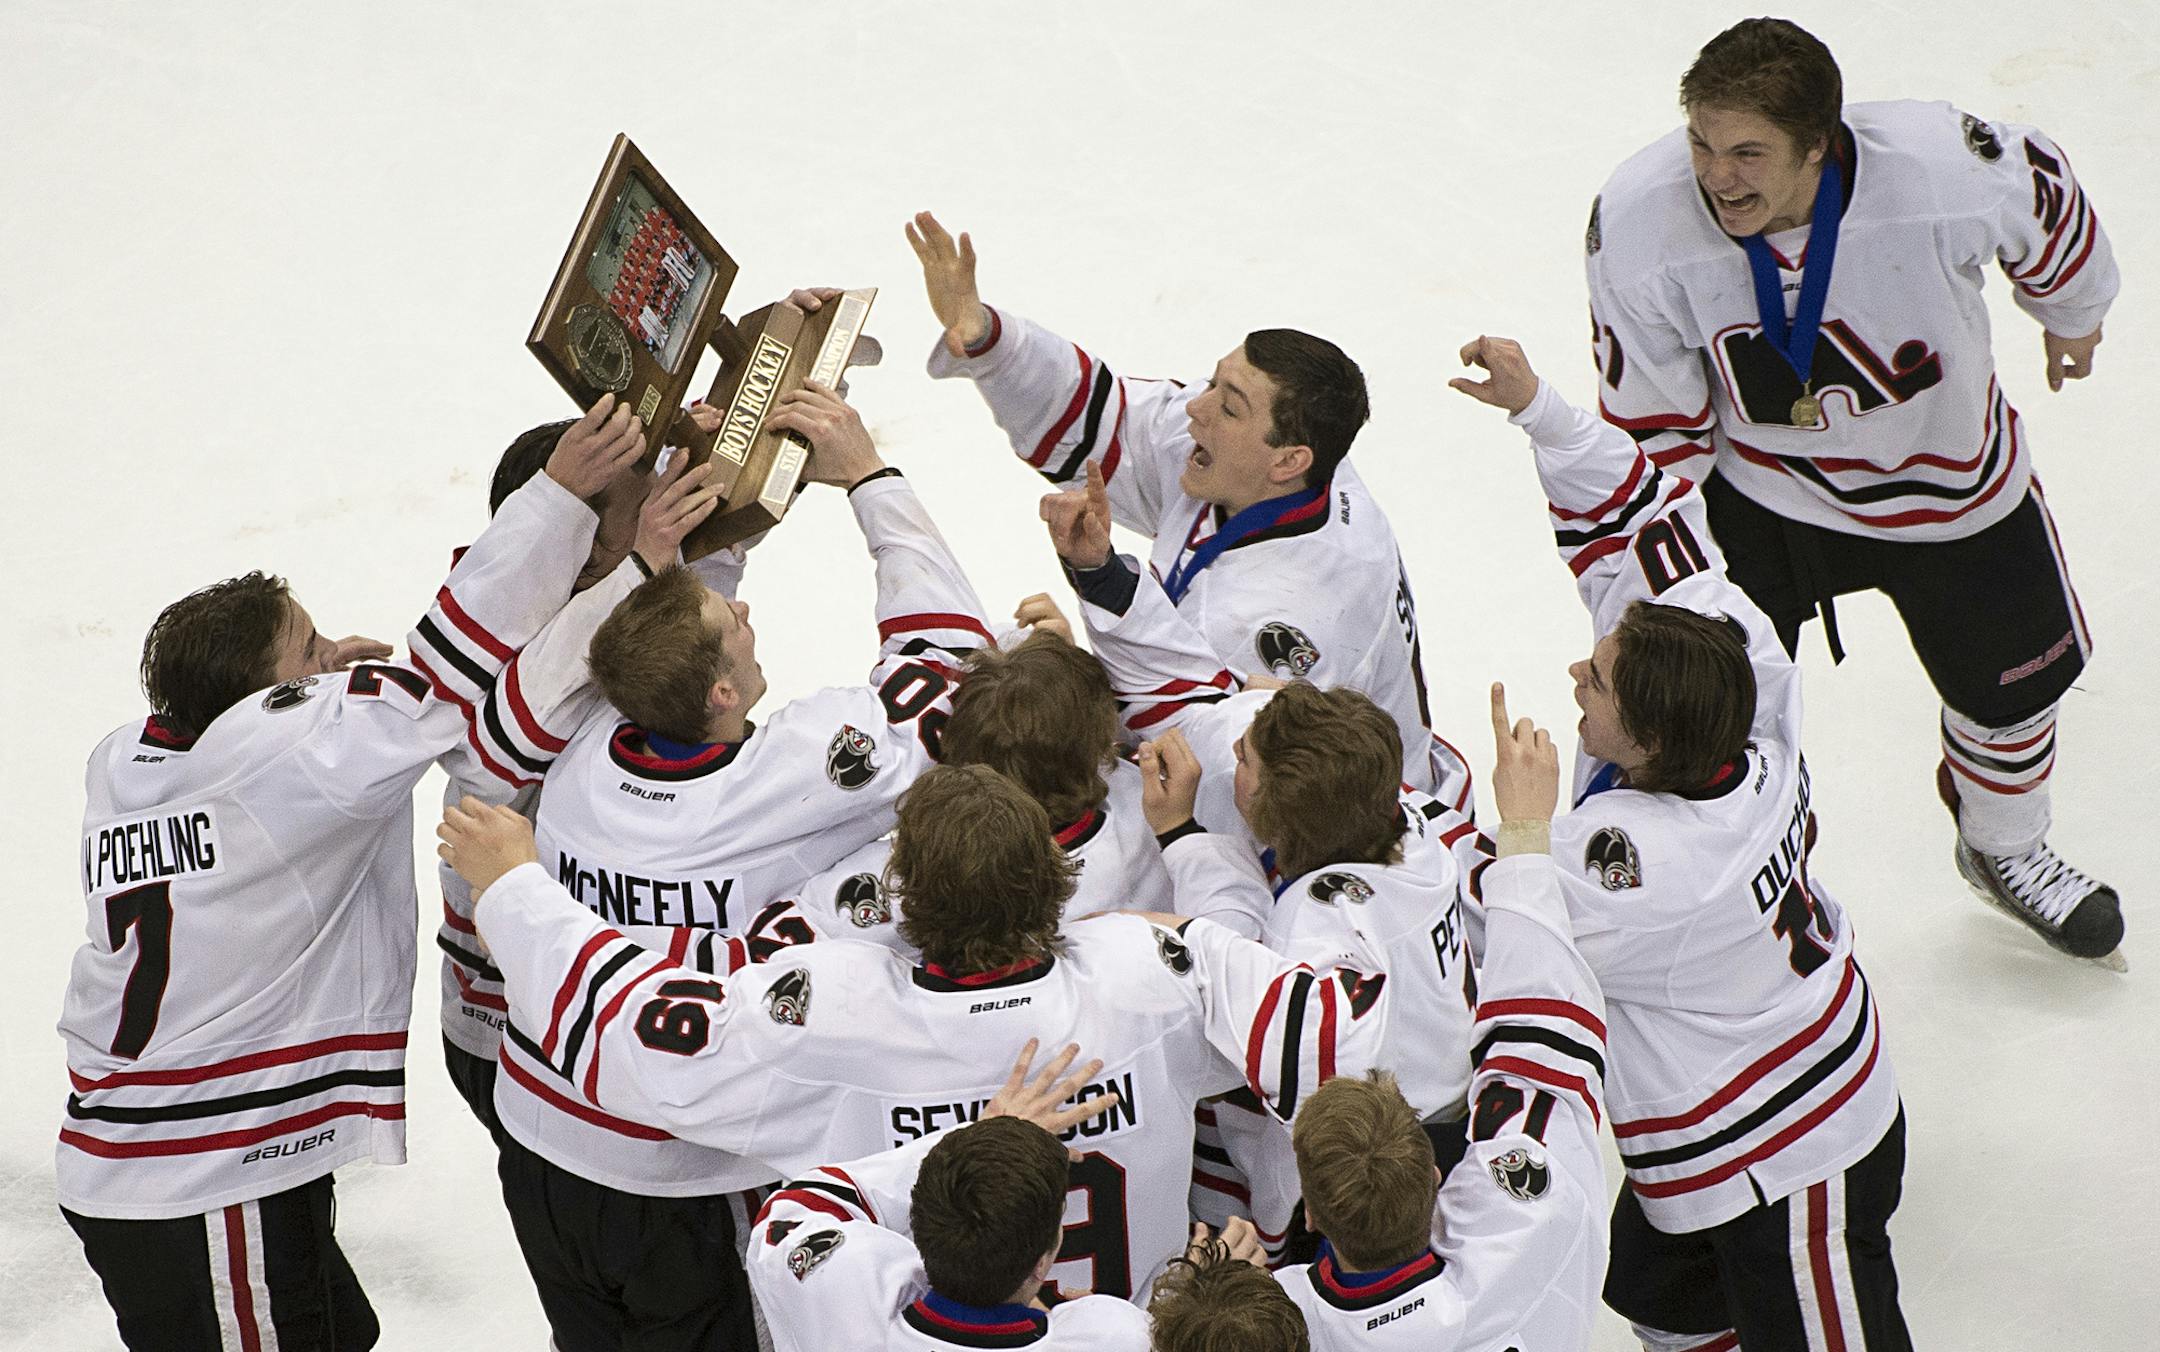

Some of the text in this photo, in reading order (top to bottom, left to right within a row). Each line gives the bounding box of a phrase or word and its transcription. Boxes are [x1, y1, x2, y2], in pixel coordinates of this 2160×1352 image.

[719, 337, 787, 463] BOYS HOCKEY
[1340, 491, 1351, 525] BAUER
[1633, 508, 1709, 597] 10
[1999, 630, 2075, 686] BAUER
[347, 664, 432, 705] 7
[618, 780, 677, 803] BAUER
[97, 811, 217, 885] POEHLING
[104, 879, 174, 1062] 7
[461, 1005, 507, 1032] BAUE
[633, 977, 726, 1057] 19
[968, 995, 1032, 1014] BAUER
[241, 1128, 336, 1165] BAUER
[1365, 1297, 1426, 1332] BAUER
